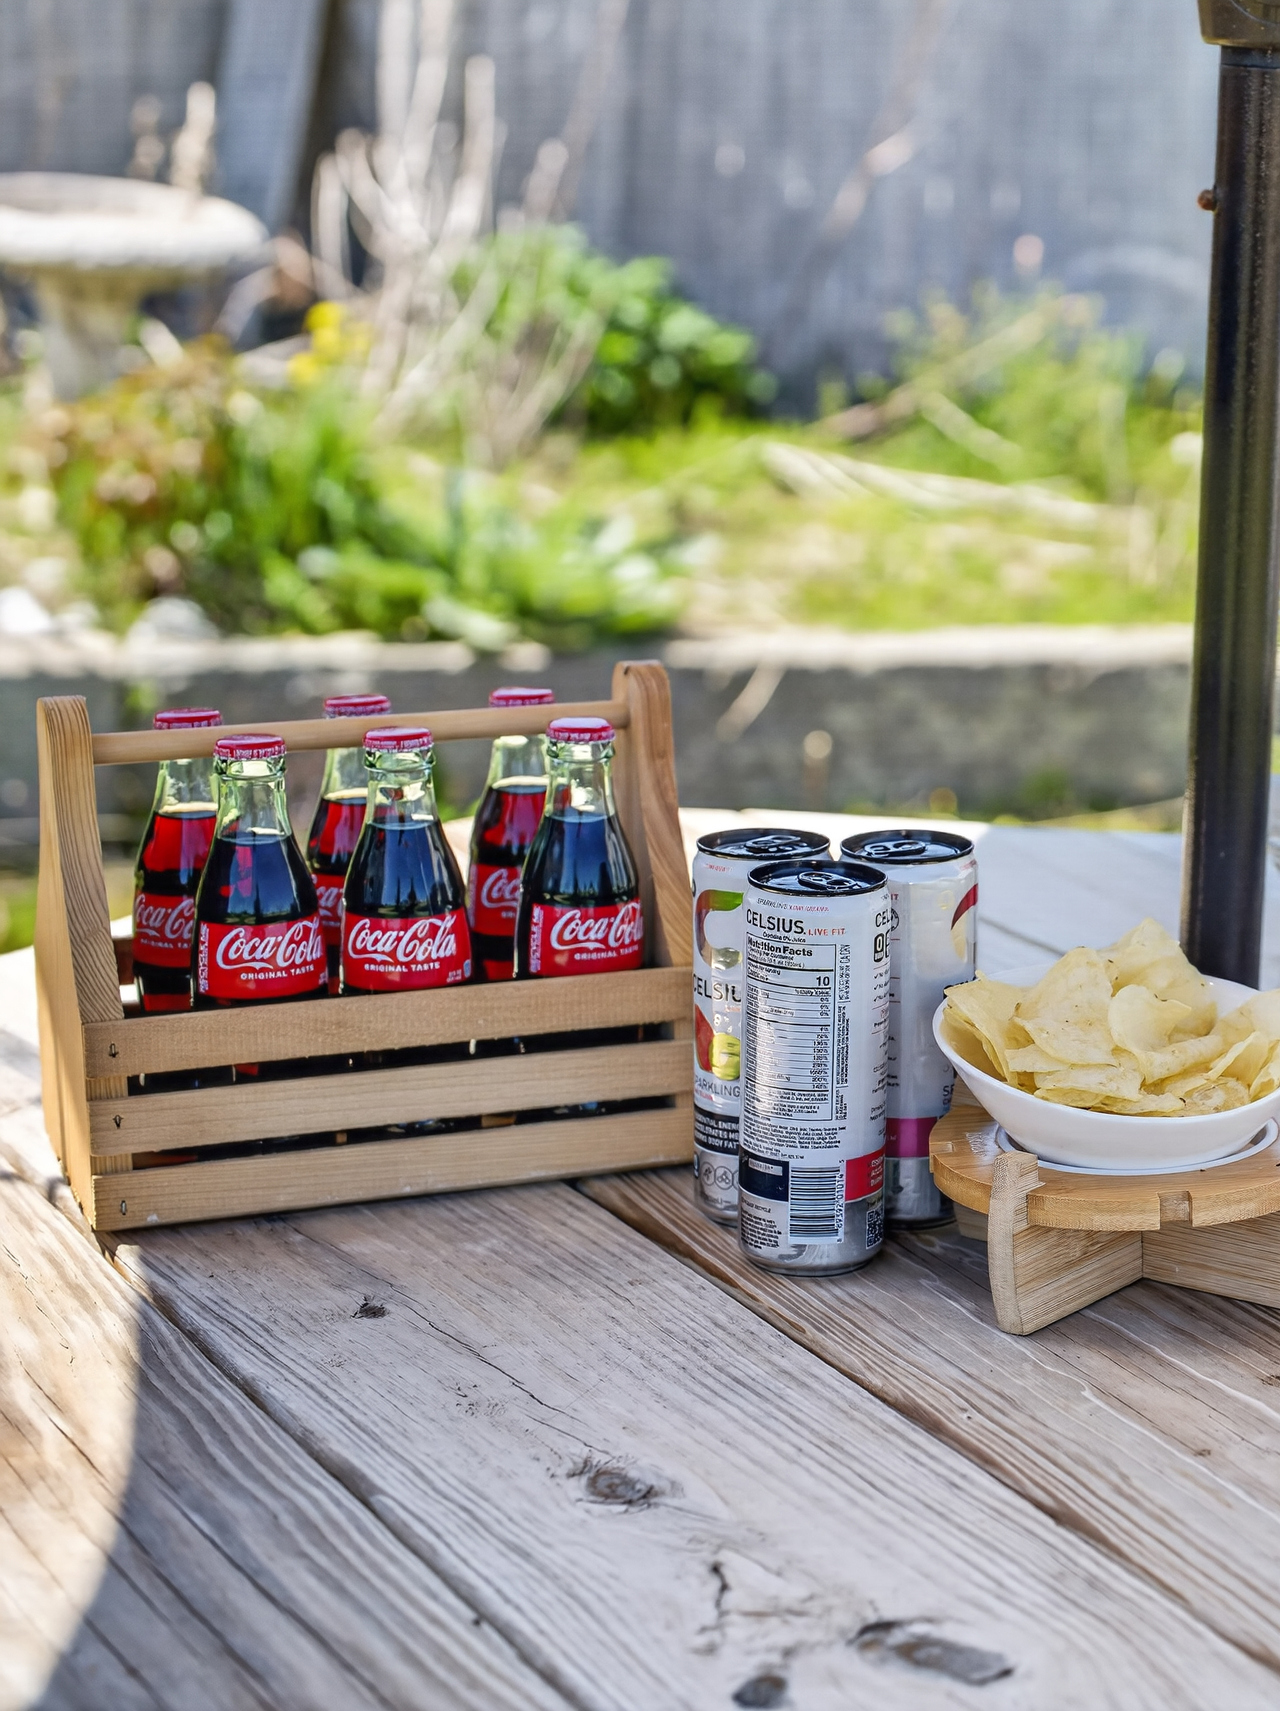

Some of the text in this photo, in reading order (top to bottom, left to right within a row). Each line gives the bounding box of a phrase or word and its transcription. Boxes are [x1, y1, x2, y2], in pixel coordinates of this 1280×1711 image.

[550, 902, 643, 950] Coca-Cola
[808, 928, 829, 936] LIVE
[216, 917, 322, 969] Coca-Cola
[348, 915, 456, 962] Coca-Cola
[574, 950, 617, 960] ORIGINAL
[783, 946, 813, 957] Facts
[240, 972, 288, 980] ORIGINAL
[290, 964, 314, 976] TASTE
[364, 962, 440, 972] ORIGINAL TASTE
[816, 976, 830, 986] 10
